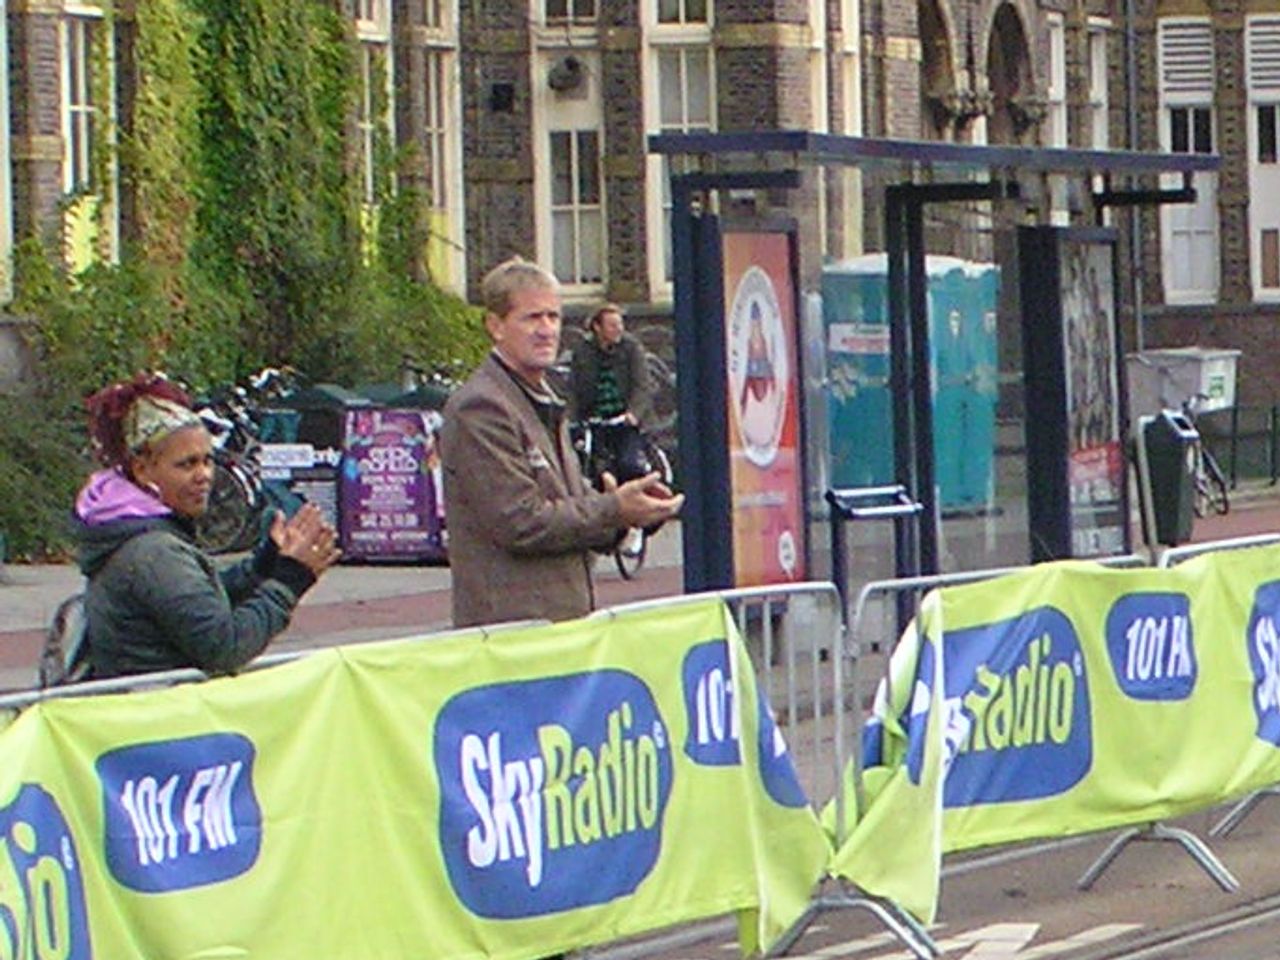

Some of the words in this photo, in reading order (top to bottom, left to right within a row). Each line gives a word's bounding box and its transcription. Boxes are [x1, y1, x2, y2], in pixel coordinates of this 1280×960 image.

[1126, 616, 1167, 681] 101
[121, 775, 180, 865] 101
[184, 760, 242, 853] FM
[461, 702, 660, 886] SkyRadio
